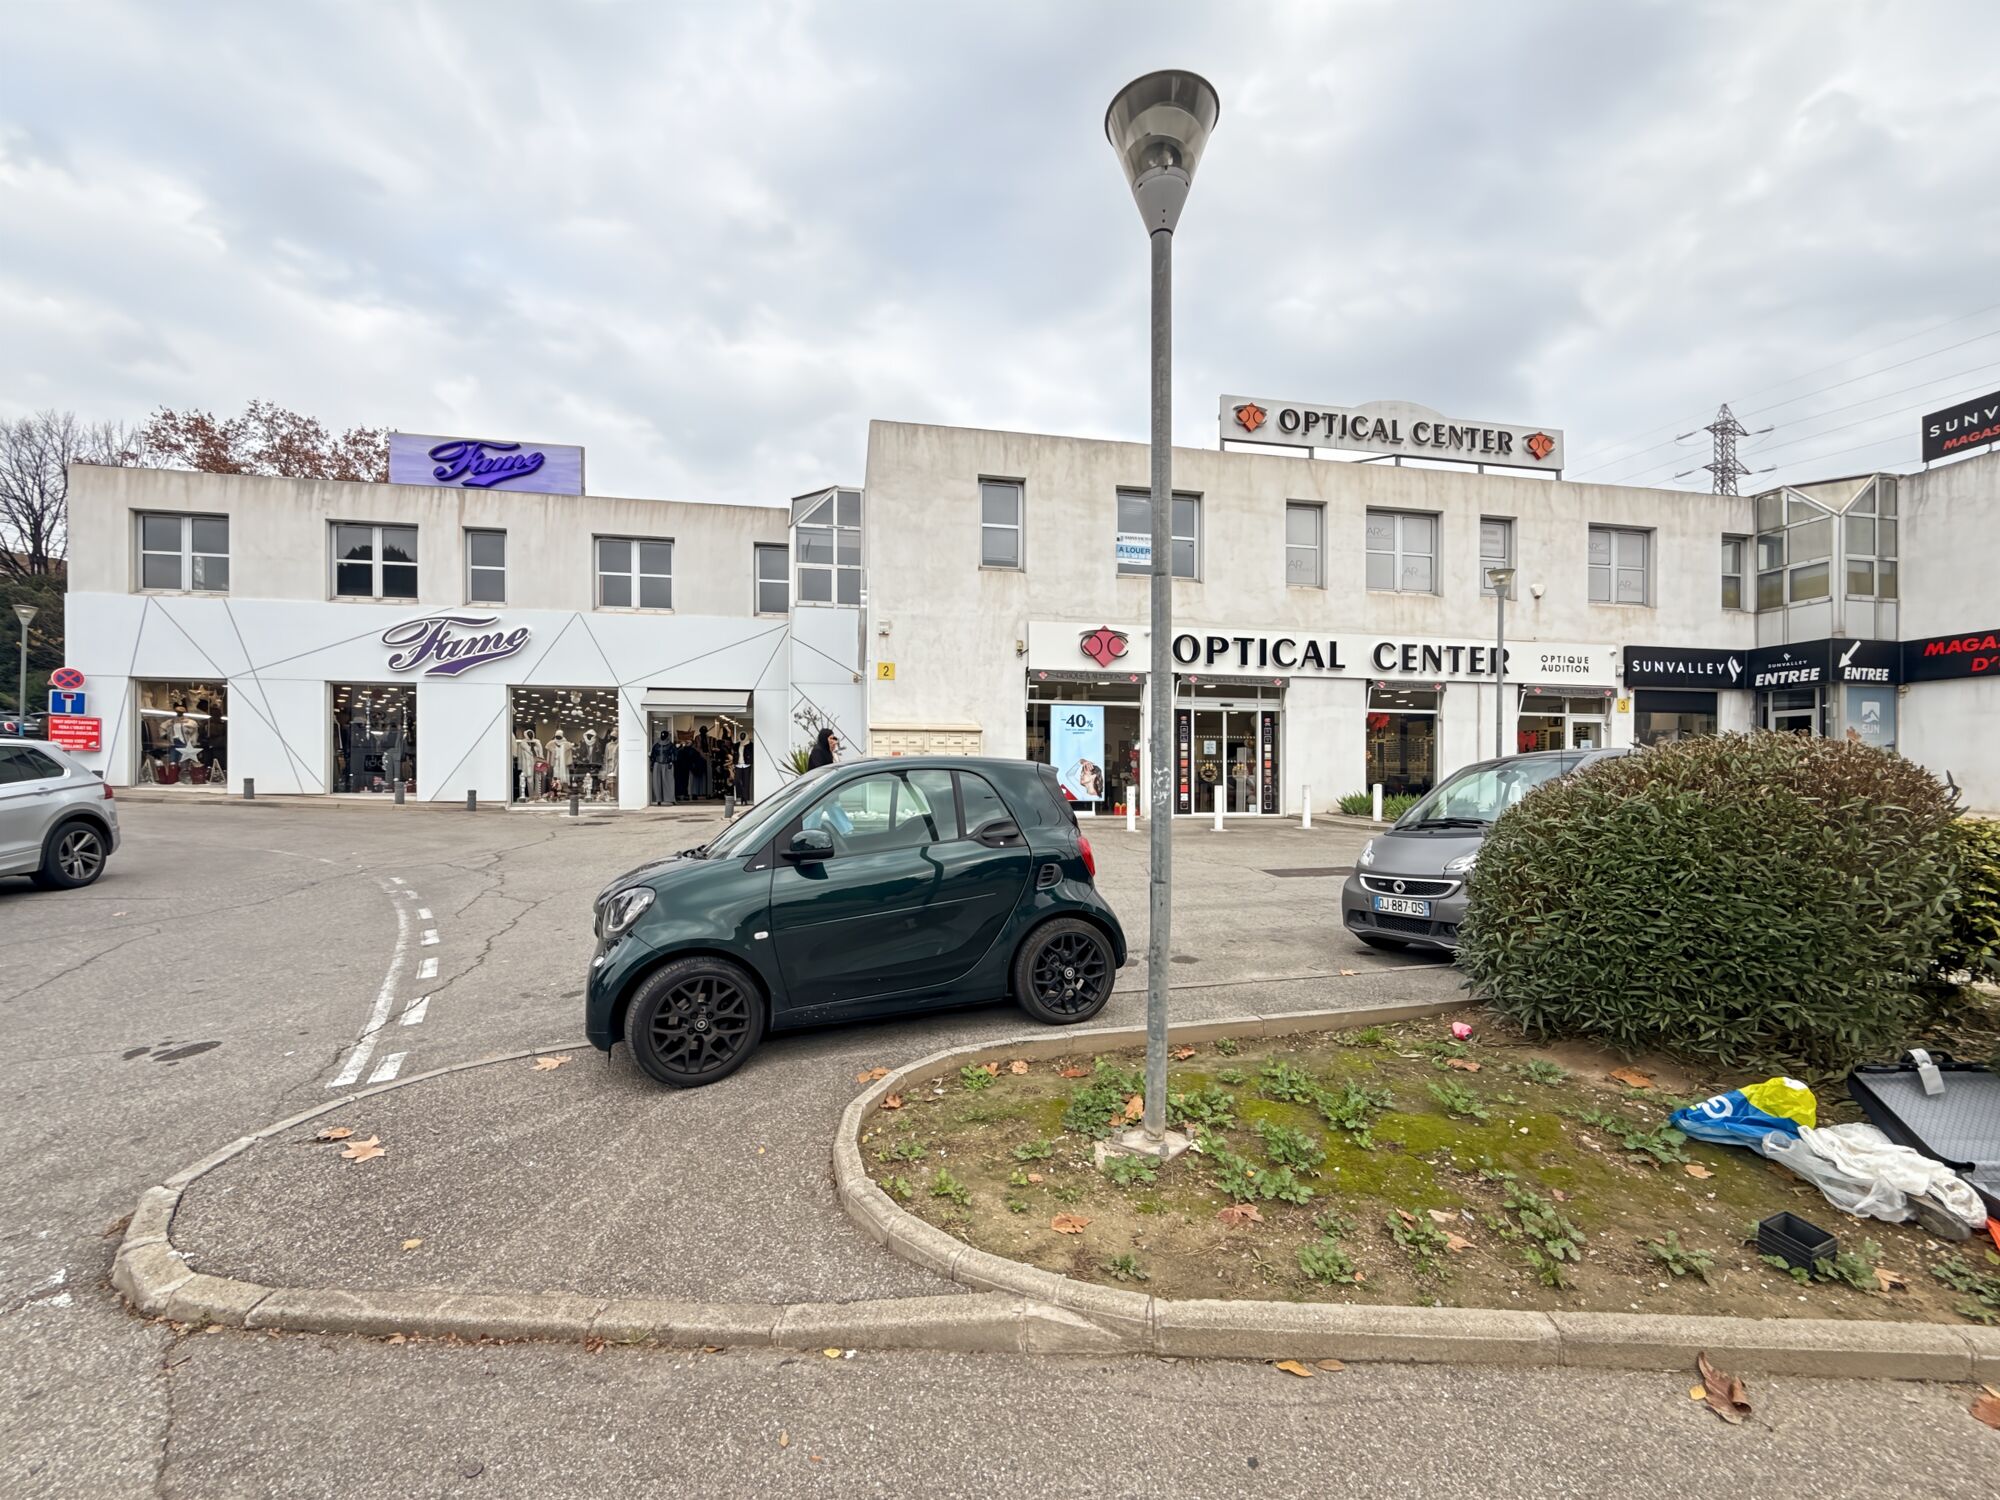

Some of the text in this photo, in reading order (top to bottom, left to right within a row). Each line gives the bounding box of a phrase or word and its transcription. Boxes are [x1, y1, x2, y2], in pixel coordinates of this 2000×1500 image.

[1278, 408, 1513, 454] OPTICAL CENTER
[428, 440, 545, 487] Fame
[1125, 547, 1151, 555] LOUER
[381, 615, 531, 676] Fame
[1172, 633, 1510, 675] OPTICAL CENTER
[1540, 654, 1589, 664] OPTIQUE
[883, 665, 890, 677] 2
[1540, 664, 1590, 673] AUDITION
[1632, 660, 1725, 675] SUNVALLEY
[1767, 660, 1808, 669] SUNVALLEY
[1755, 667, 1821, 687] ENTREE
[1843, 666, 1890, 682] ENTREE
[1620, 701, 1626, 711] 3
